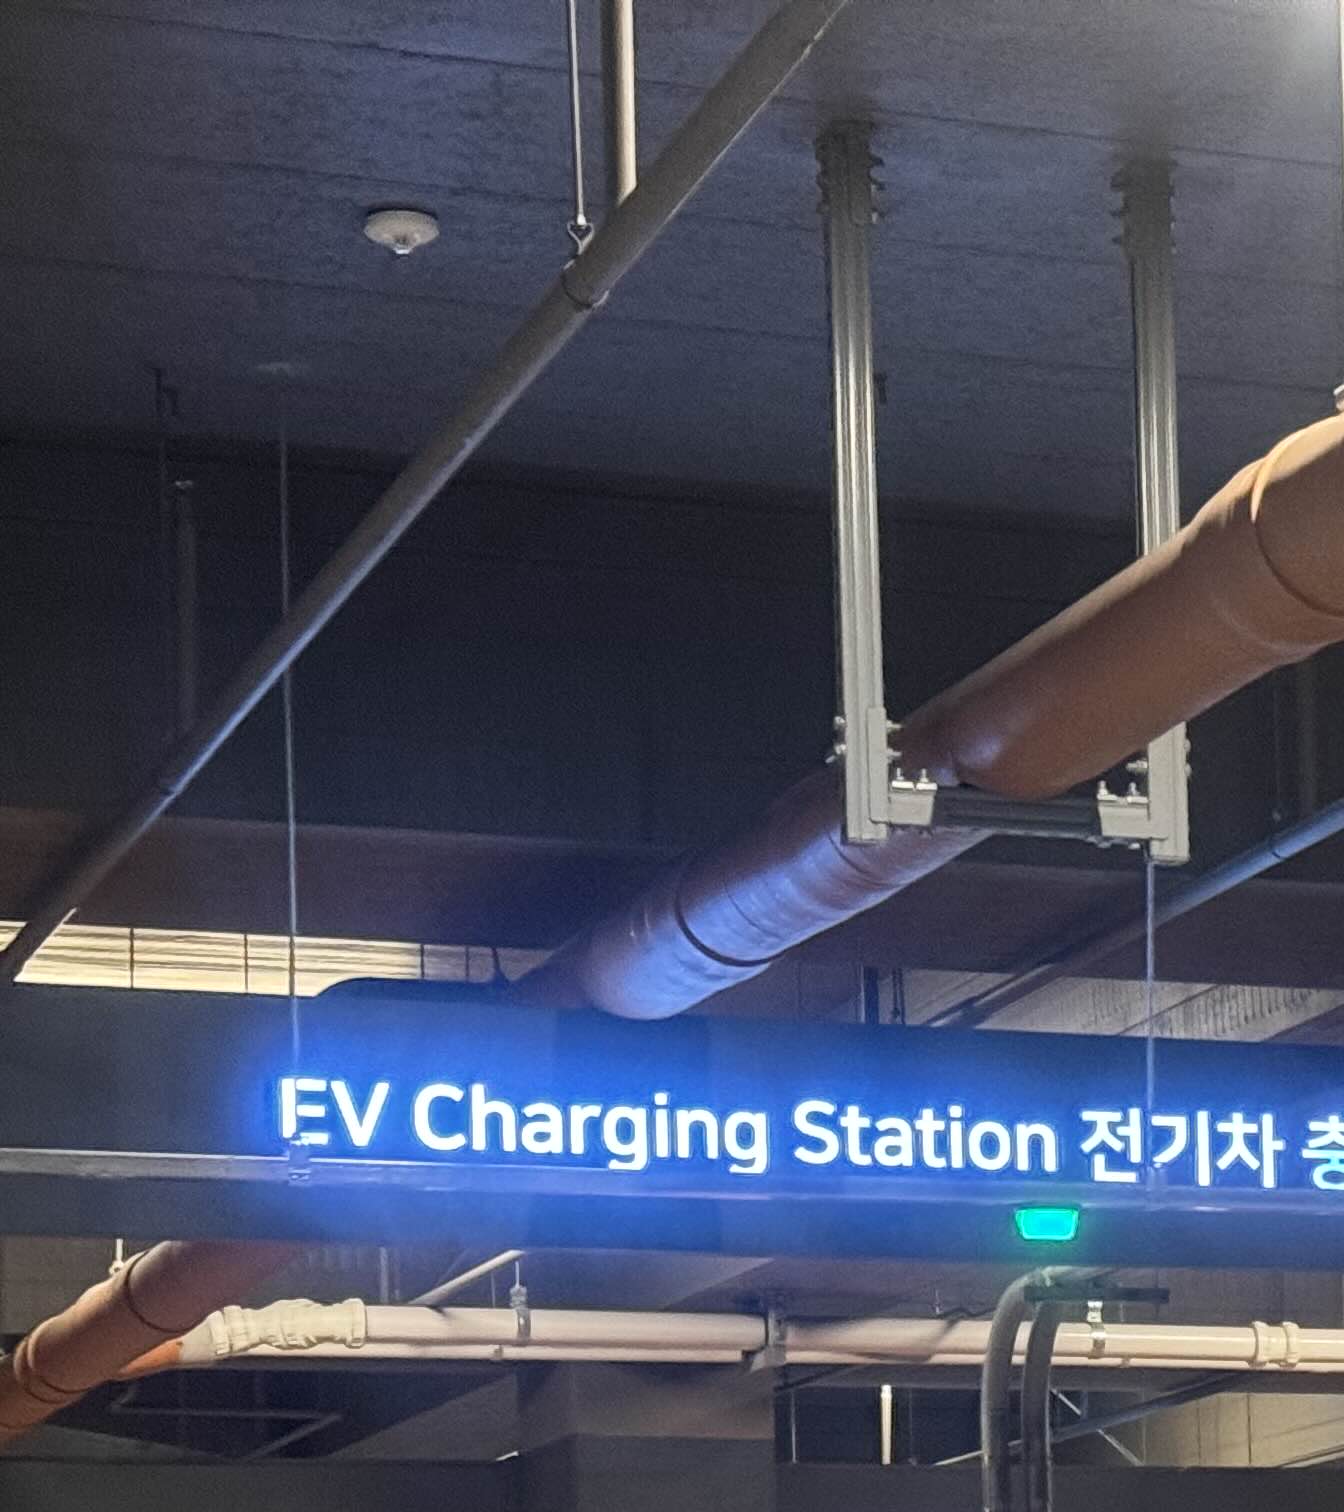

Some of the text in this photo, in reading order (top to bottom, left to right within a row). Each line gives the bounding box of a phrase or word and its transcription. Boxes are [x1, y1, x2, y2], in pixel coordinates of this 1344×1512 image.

[280, 1077, 391, 1147] EV
[413, 1083, 768, 1175] Charging
[793, 1099, 1057, 1173] Station
[1080, 1107, 1287, 1189] 전기차
